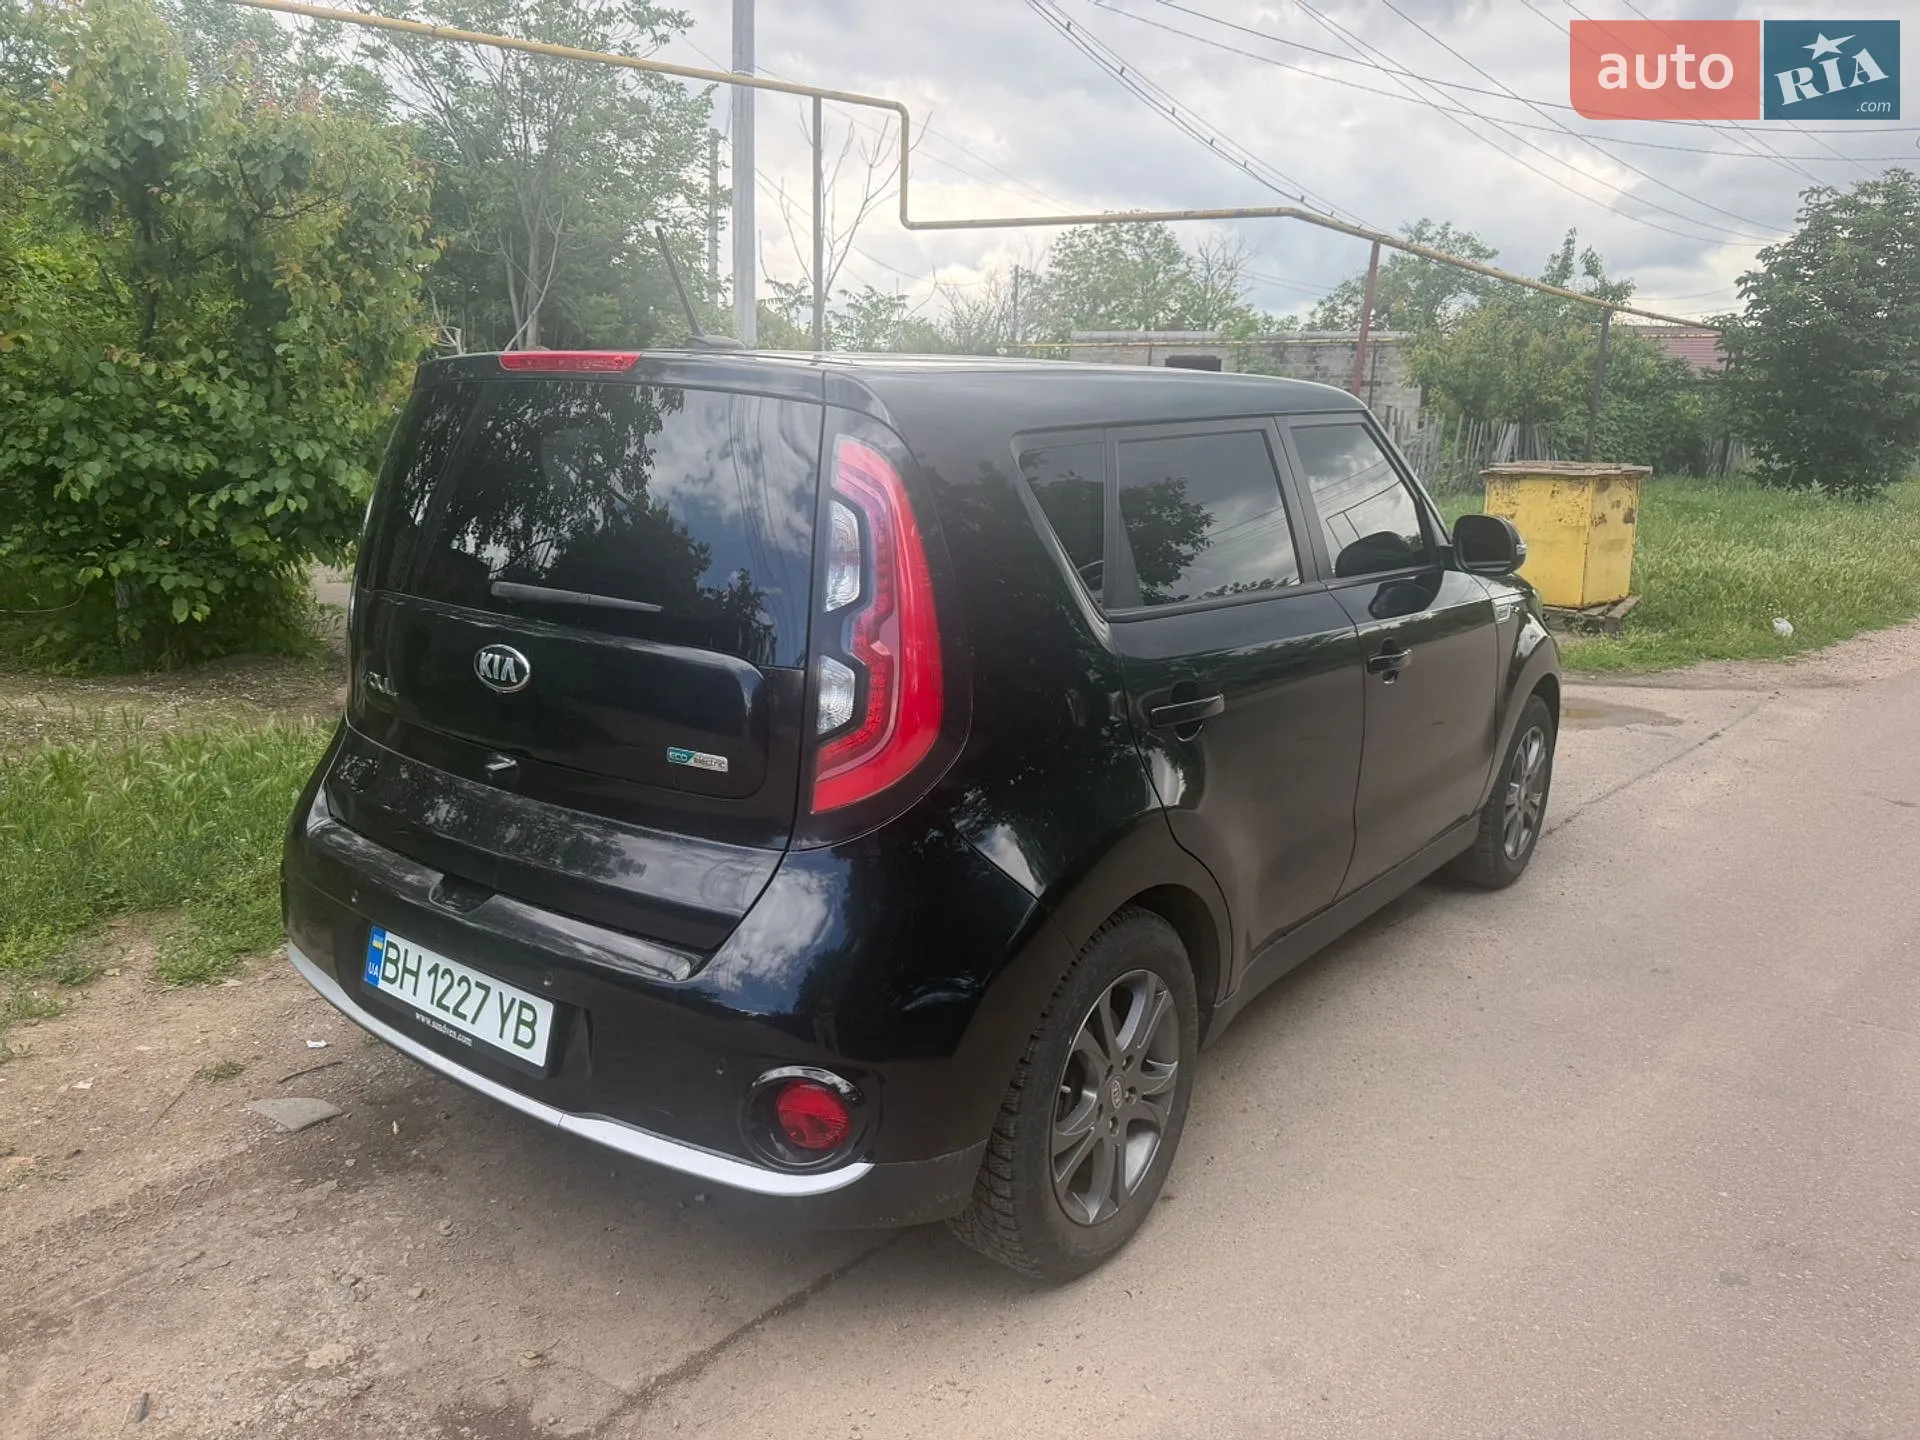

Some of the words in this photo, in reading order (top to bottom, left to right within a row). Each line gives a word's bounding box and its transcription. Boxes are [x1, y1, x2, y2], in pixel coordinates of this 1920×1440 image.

[478, 651, 518, 683] KIA
[368, 960, 379, 978] UA
[380, 940, 423, 997] BH
[427, 962, 492, 1025] 1227
[498, 990, 539, 1051] YB
